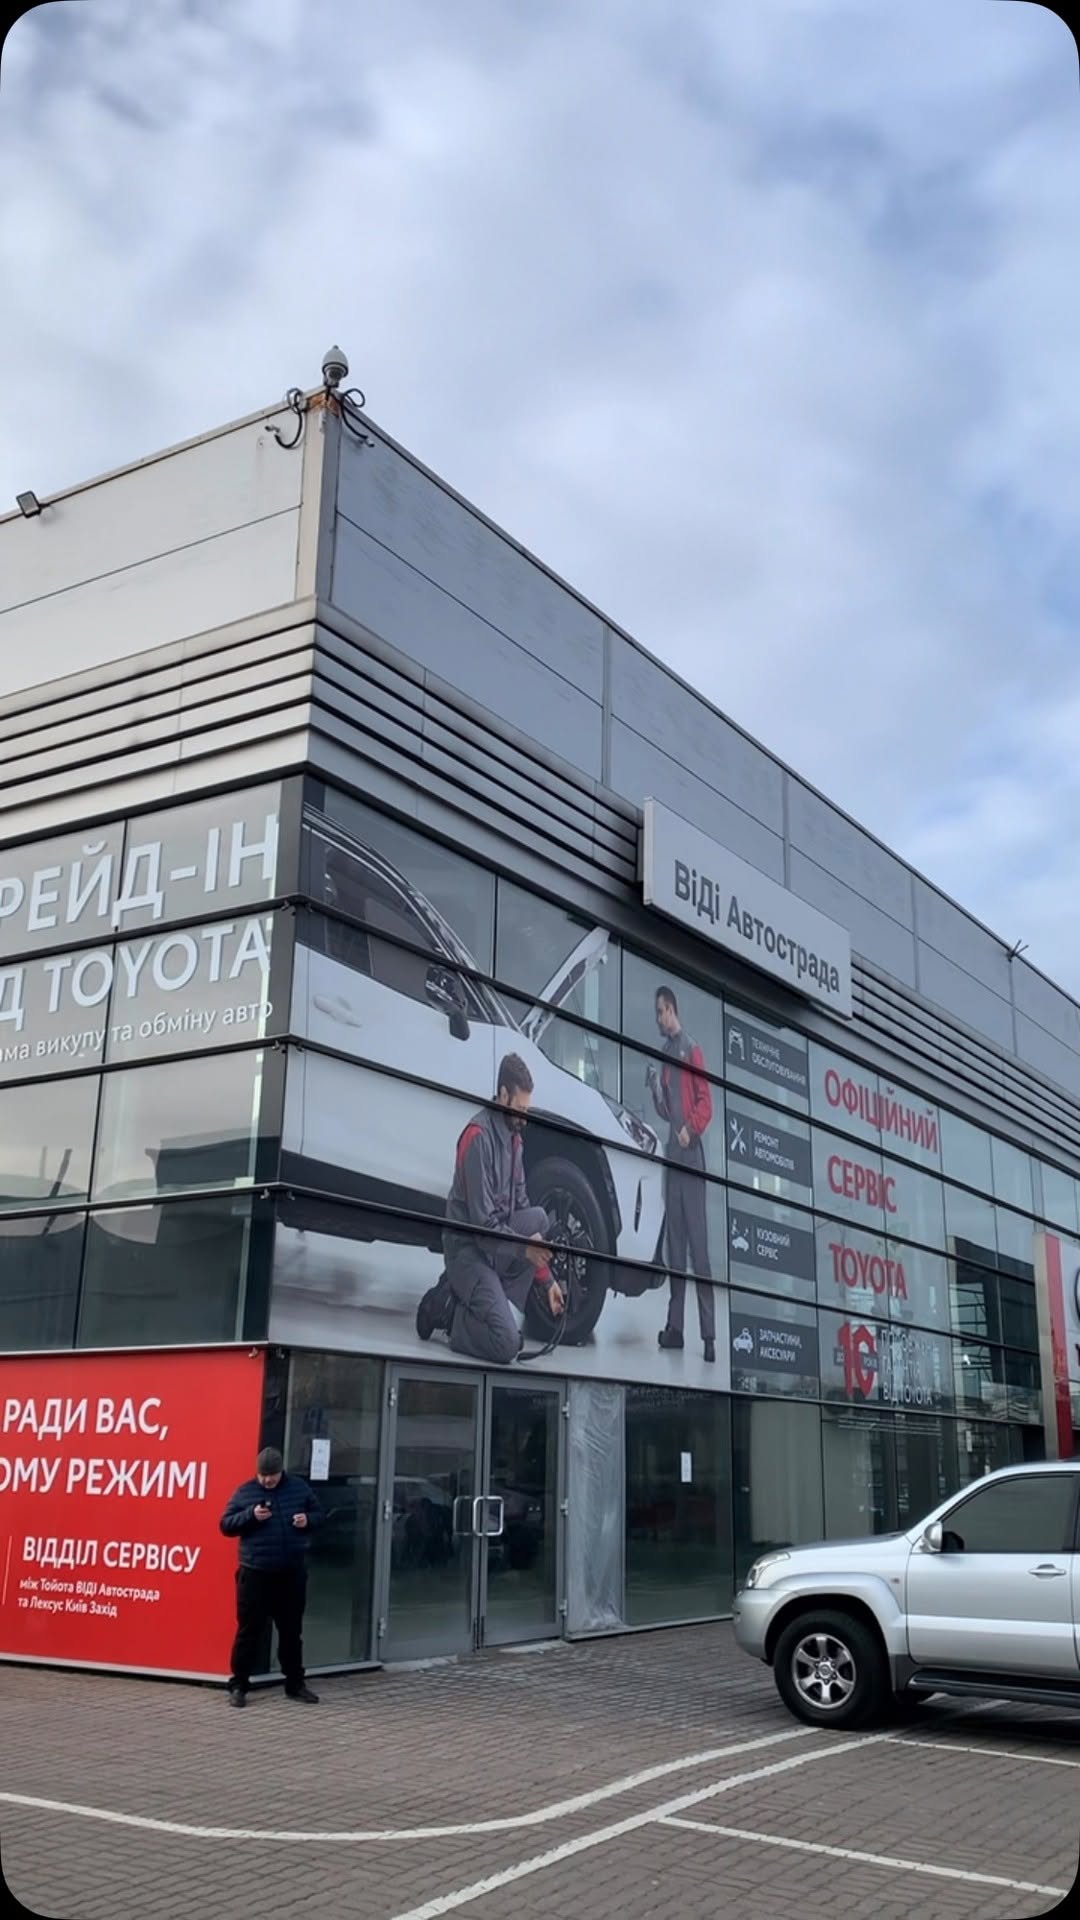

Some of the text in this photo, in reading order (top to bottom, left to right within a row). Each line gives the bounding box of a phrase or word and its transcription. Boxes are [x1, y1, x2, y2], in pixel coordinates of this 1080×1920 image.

[675, 859, 840, 993] ВіДі Автострада
[43, 917, 271, 1013] TOYOTA
[36, 1029, 105, 1056] викупу
[111, 1024, 133, 1042] та
[139, 1008, 216, 1038] обміну
[222, 1001, 273, 1025] авто
[825, 1069, 938, 1153] ОФІЦІЙНИЙ
[827, 1155, 897, 1213] СЕРВІС
[756, 1243, 779, 1260] СЕРВІС
[829, 1243, 908, 1300] TOYOTA
[3, 1397, 169, 1441] РАДИ ВАС,
[66, 1458, 208, 1500] РЕЖИМІ
[22, 1536, 201, 1573] ВІДДІЛ СЕРВІСУ
[17, 1596, 118, 1618] та Лексус Київ Захід
[19, 1576, 39, 1590] між
[40, 1578, 74, 1593] Тойота
[98, 1583, 160, 1602] Автострада
